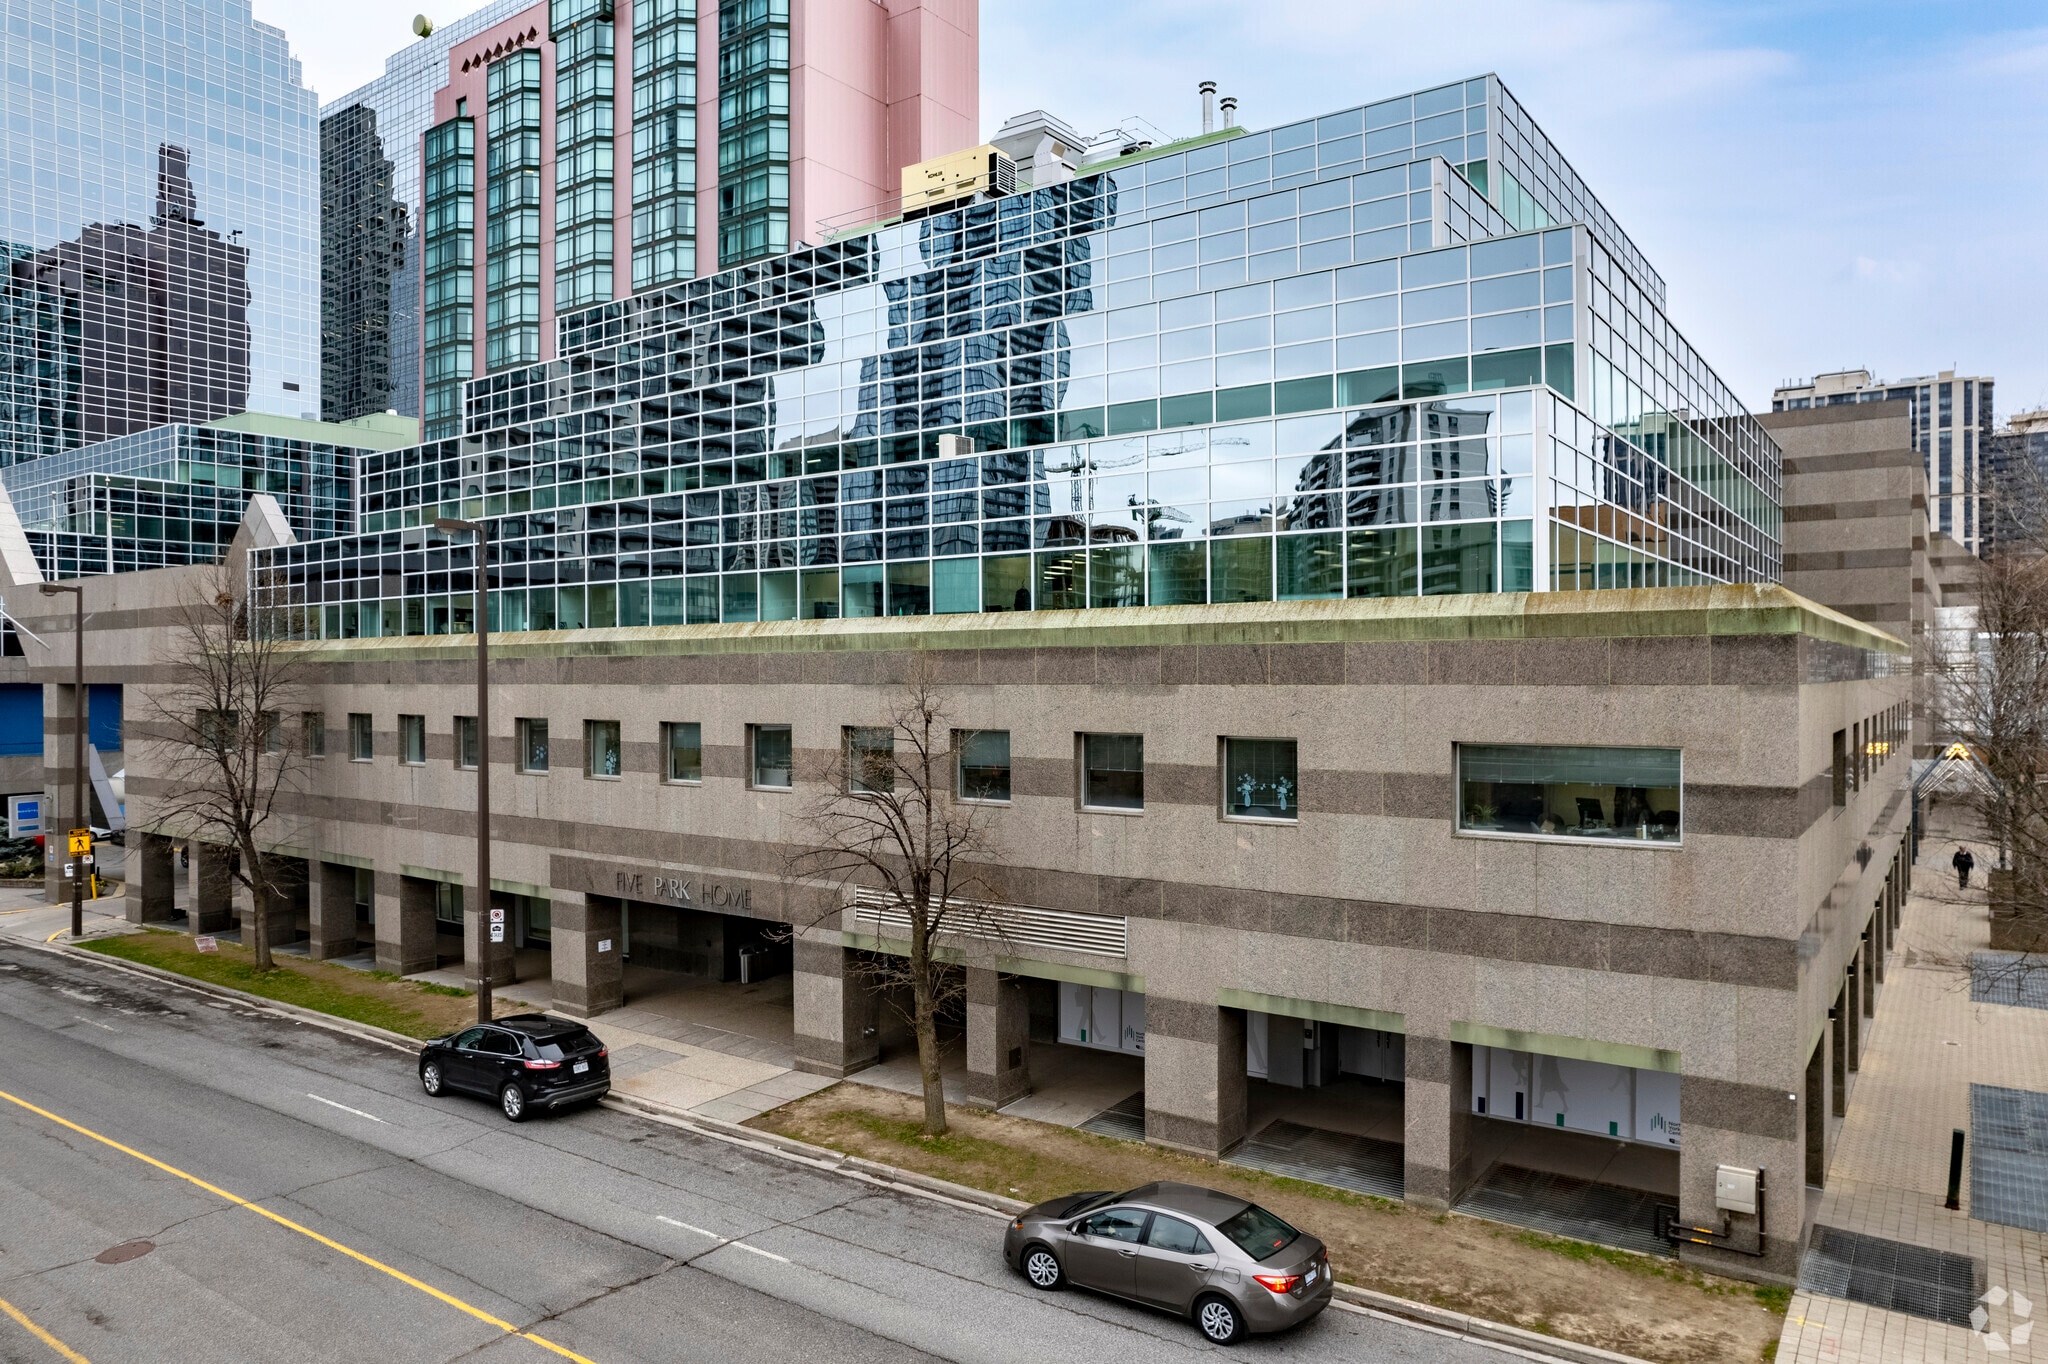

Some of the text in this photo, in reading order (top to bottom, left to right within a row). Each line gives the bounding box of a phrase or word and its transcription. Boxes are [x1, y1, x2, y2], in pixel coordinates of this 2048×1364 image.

[616, 872, 752, 910] FIVE PARK HOME
